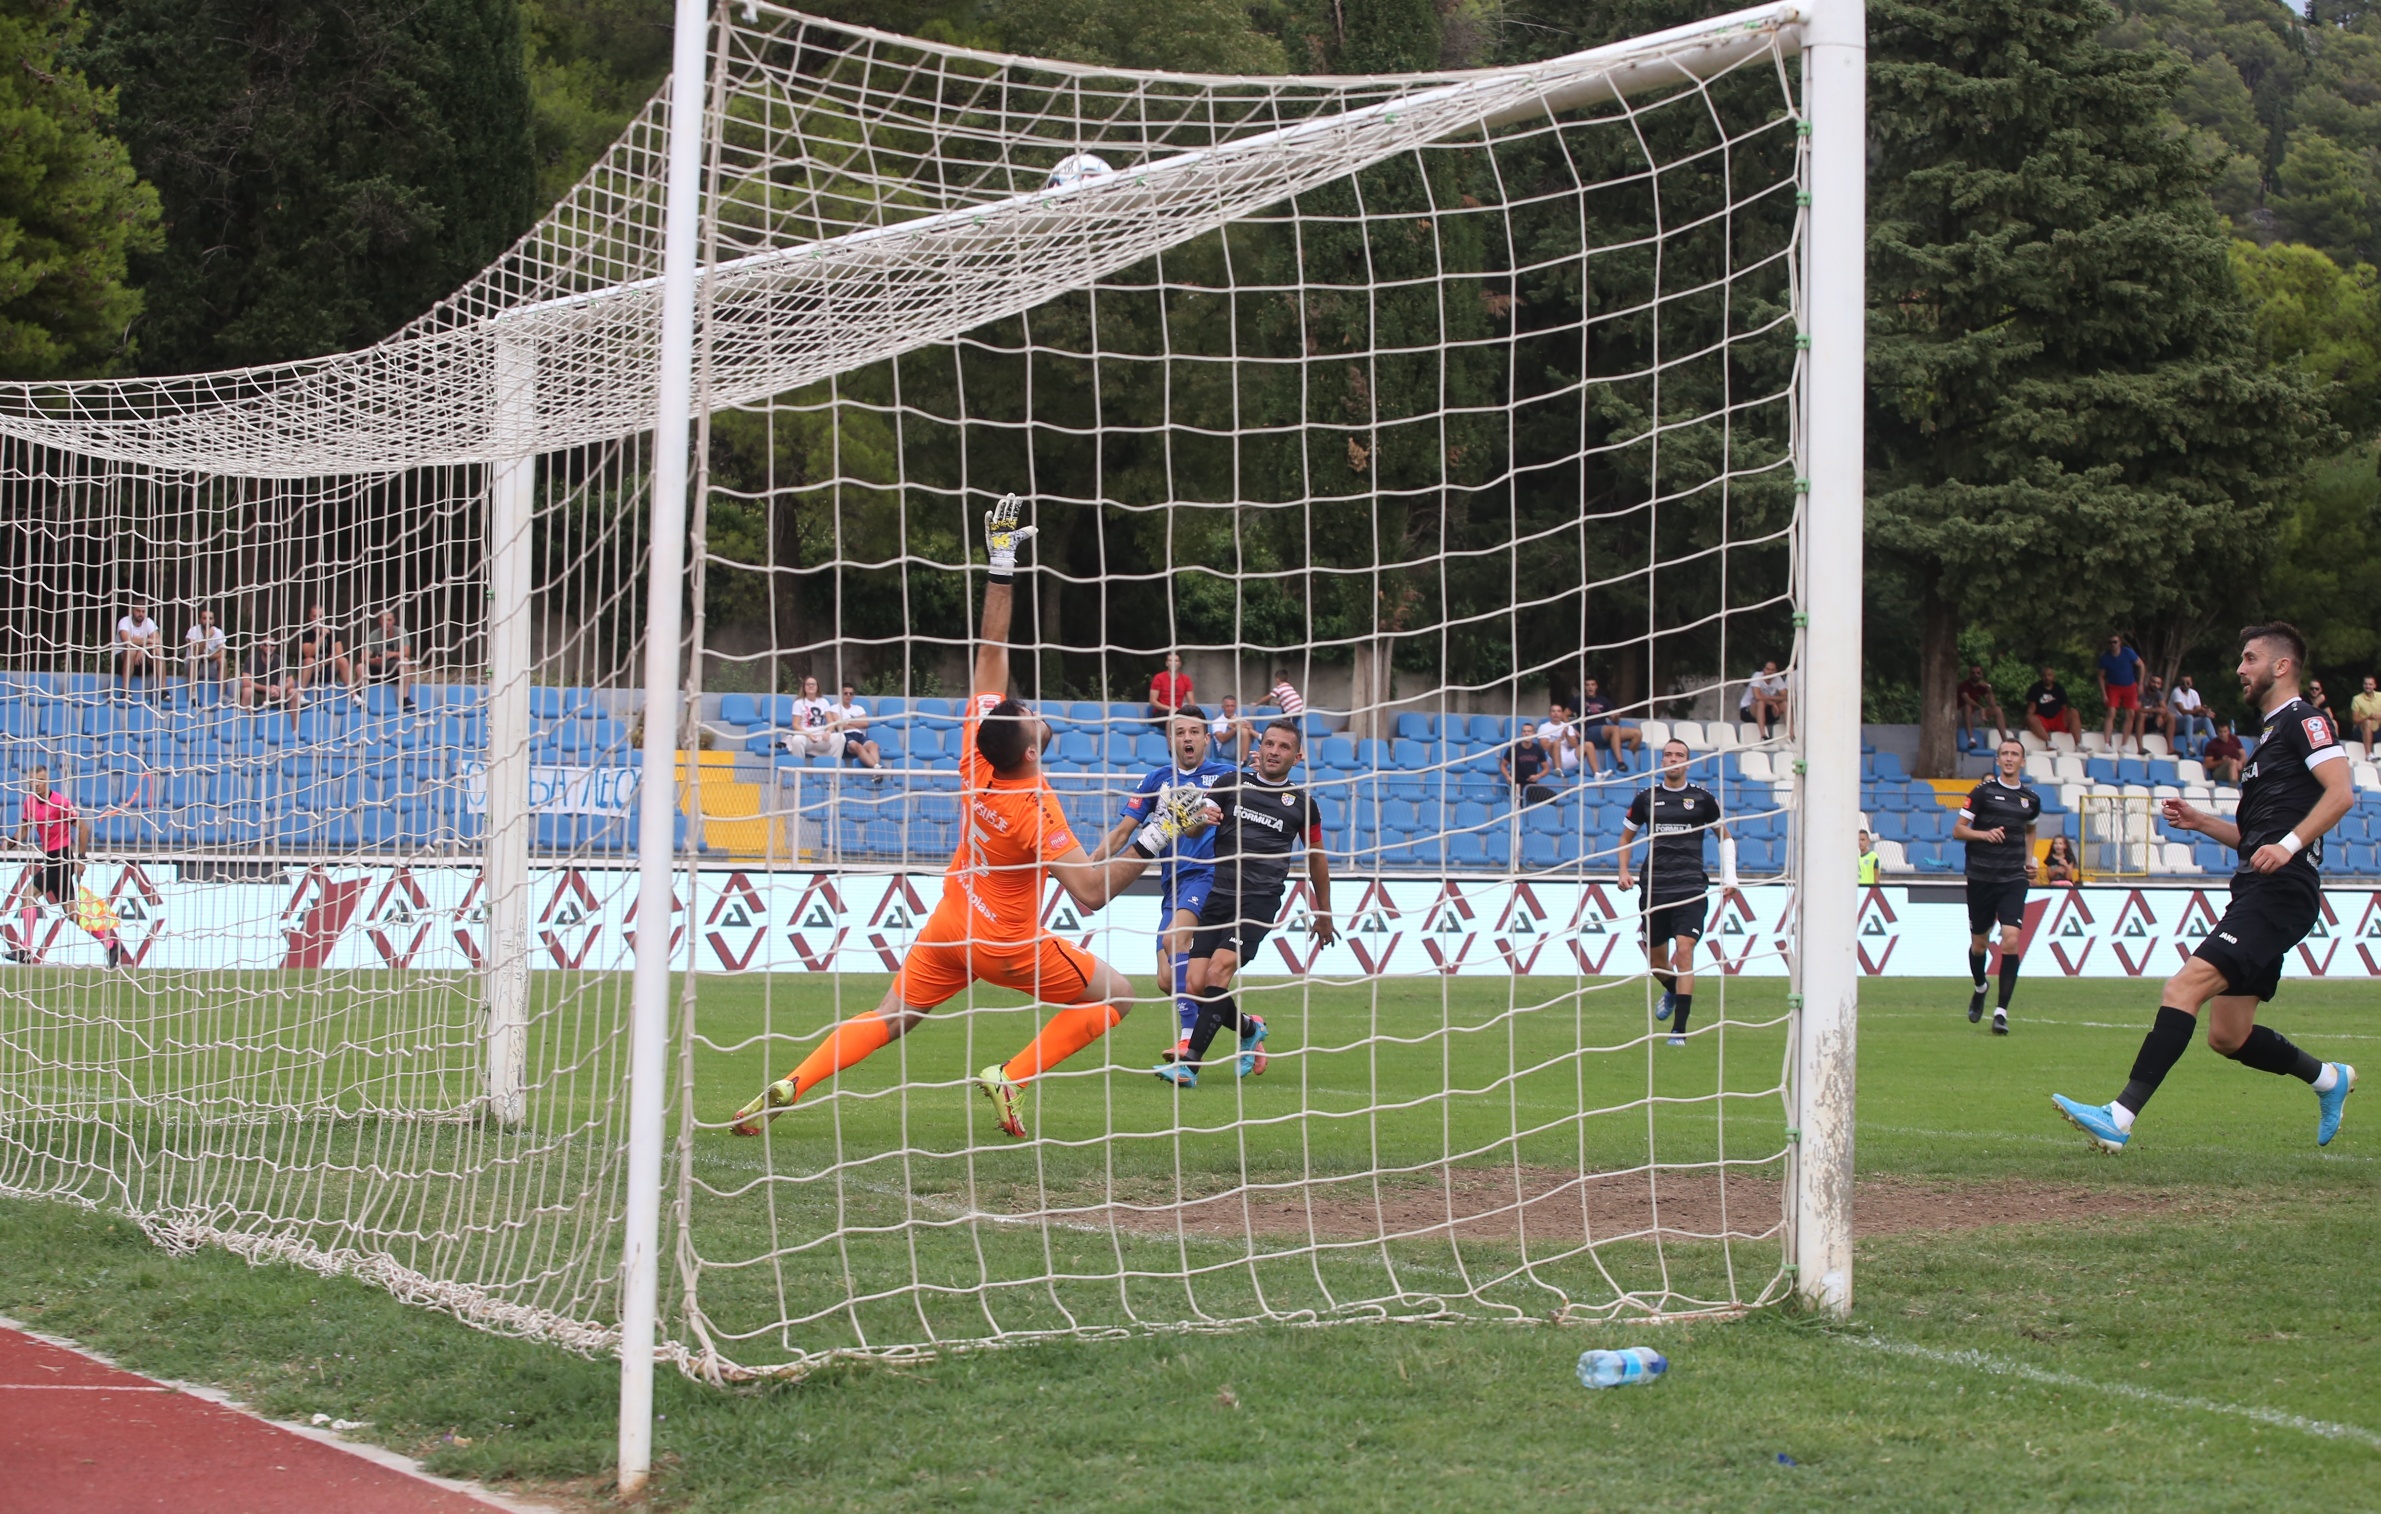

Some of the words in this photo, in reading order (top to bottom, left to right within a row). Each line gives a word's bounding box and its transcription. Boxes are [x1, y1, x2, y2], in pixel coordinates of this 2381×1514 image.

[1233, 804, 1284, 832] FORMULA
[1655, 823, 1692, 833] FORMULA
[2219, 932, 2238, 945] JAKO
